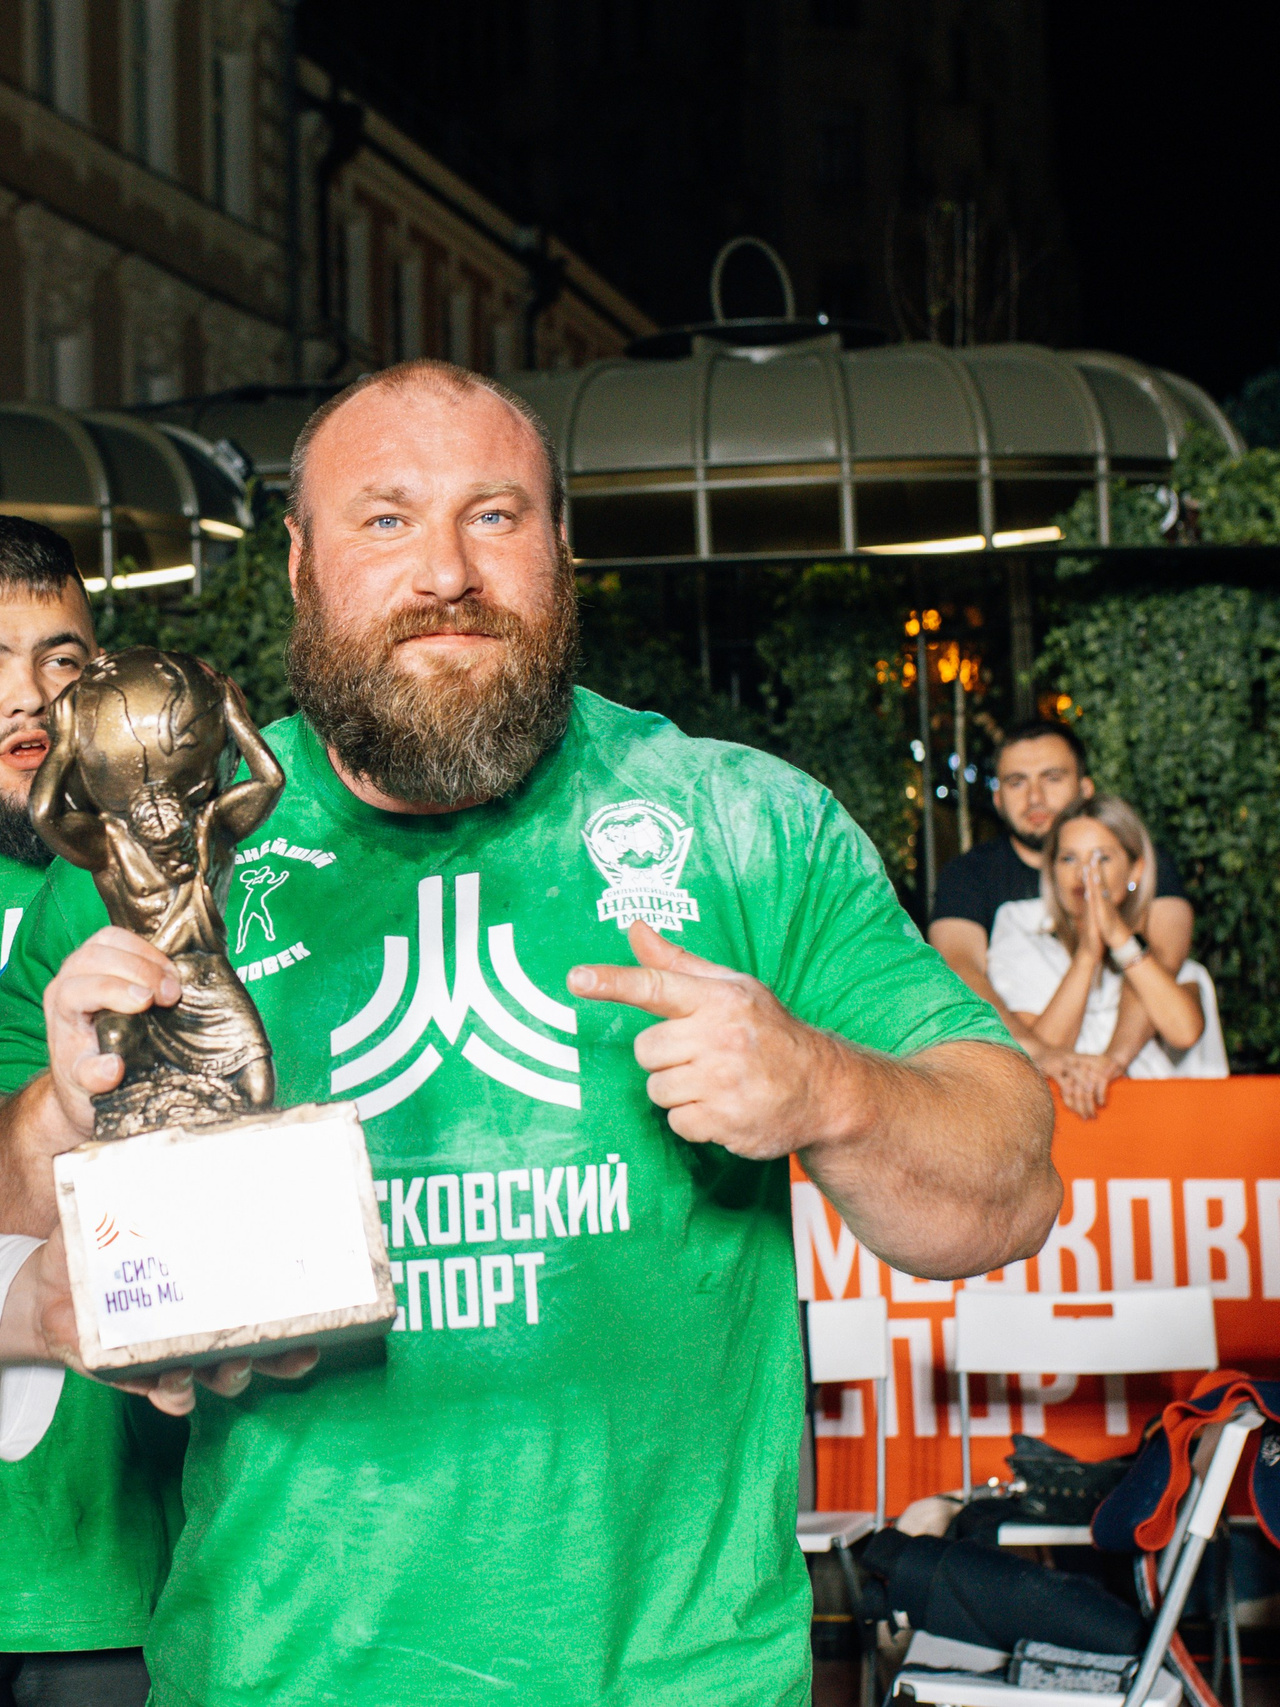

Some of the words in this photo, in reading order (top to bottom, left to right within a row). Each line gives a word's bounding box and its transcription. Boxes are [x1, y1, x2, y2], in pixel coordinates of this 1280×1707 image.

[602, 896, 694, 916] НАЦИЯ
[622, 912, 677, 927] МИРА
[105, 1286, 152, 1314] НОЧЬ
